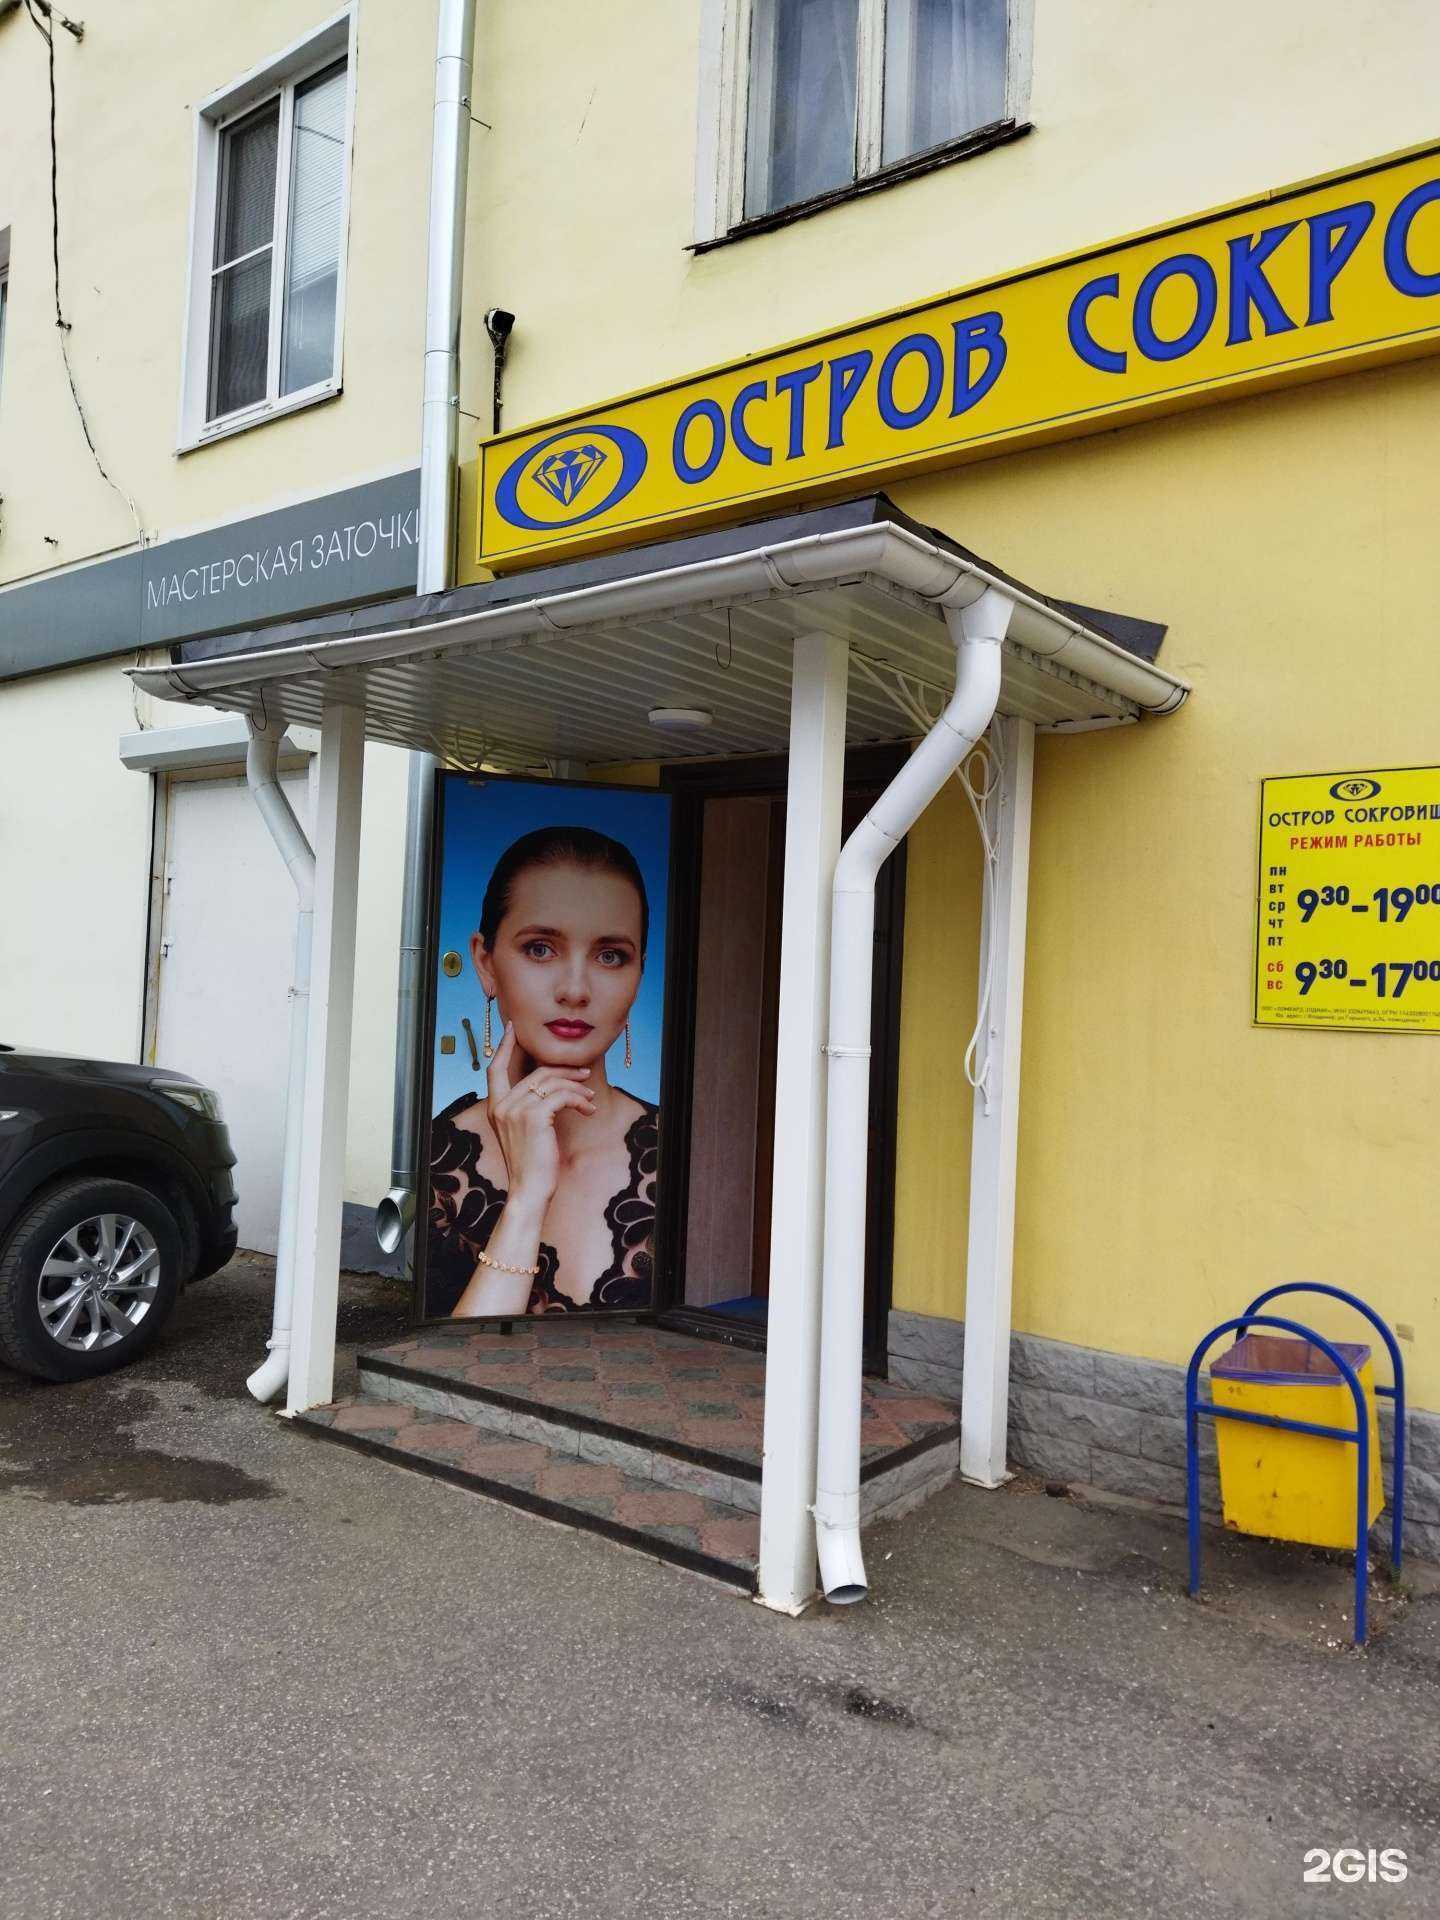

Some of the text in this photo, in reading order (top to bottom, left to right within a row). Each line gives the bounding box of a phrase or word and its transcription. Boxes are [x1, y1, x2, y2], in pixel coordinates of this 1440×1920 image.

[672, 310, 1008, 484] ОСТРОВ
[146, 539, 304, 610] МАСТЕРСКАЯ
[1269, 809, 1335, 827] ОСТРОВ
[1290, 832, 1421, 850] РЕЖИМ РАБОТЫ
[1270, 866, 1287, 876] пн
[1269, 884, 1285, 894] вт
[1268, 901, 1286, 914] ср
[1268, 918, 1284, 929] чт
[1267, 936, 1284, 946] пт
[1267, 961, 1284, 973] сб
[1267, 980, 1283, 990] вс
